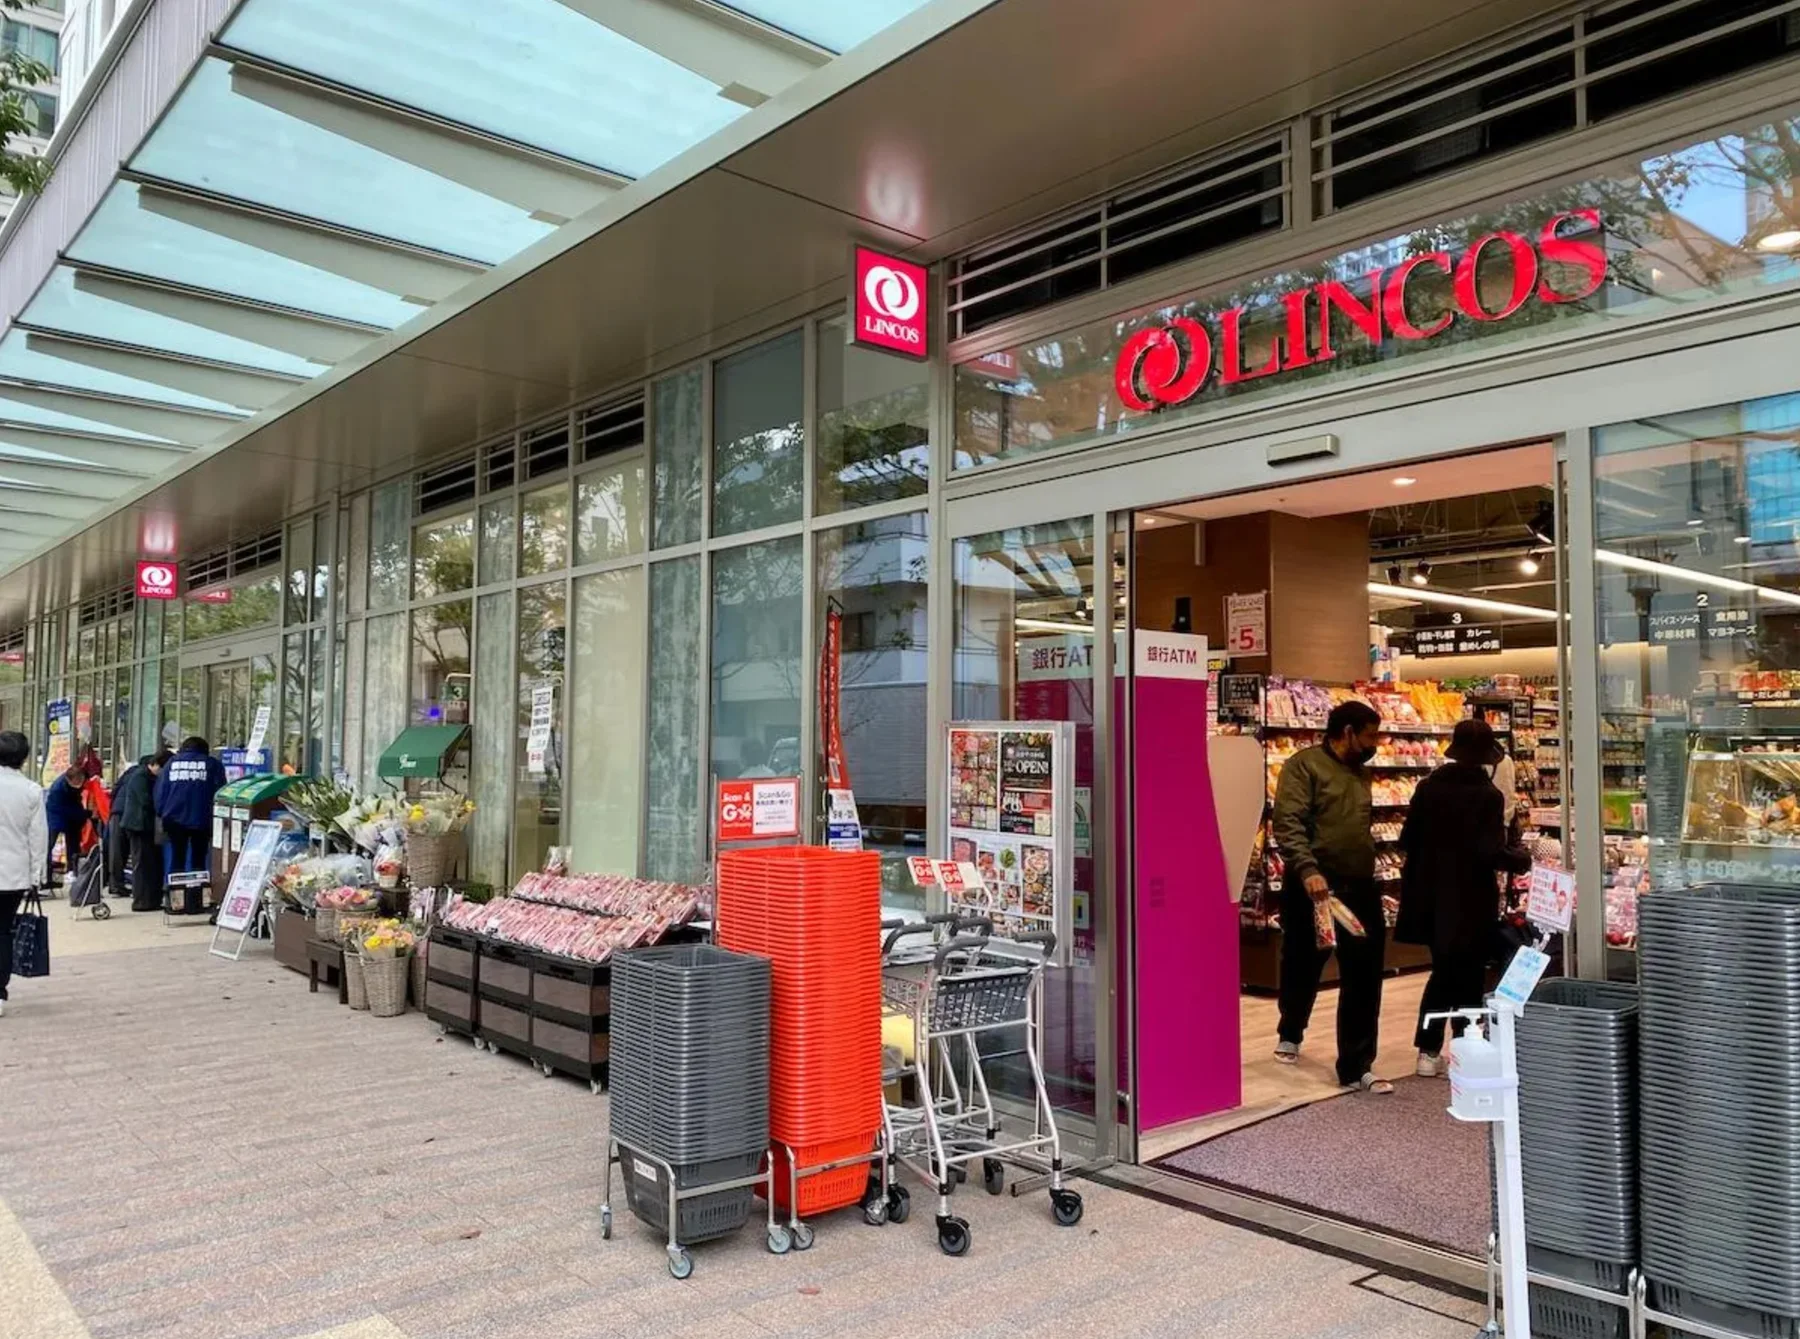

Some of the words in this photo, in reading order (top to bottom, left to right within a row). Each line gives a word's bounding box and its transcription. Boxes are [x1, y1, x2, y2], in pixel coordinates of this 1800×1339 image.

[1218, 208, 1607, 387] LINCOS
[864, 315, 920, 344] LINCOS
[1696, 593, 1709, 607] 2
[1451, 611, 1463, 625] 3
[1466, 628, 1492, 638] カレー
[1032, 643, 1117, 669] 銀行AT
[1147, 645, 1197, 665] 銀行ATM
